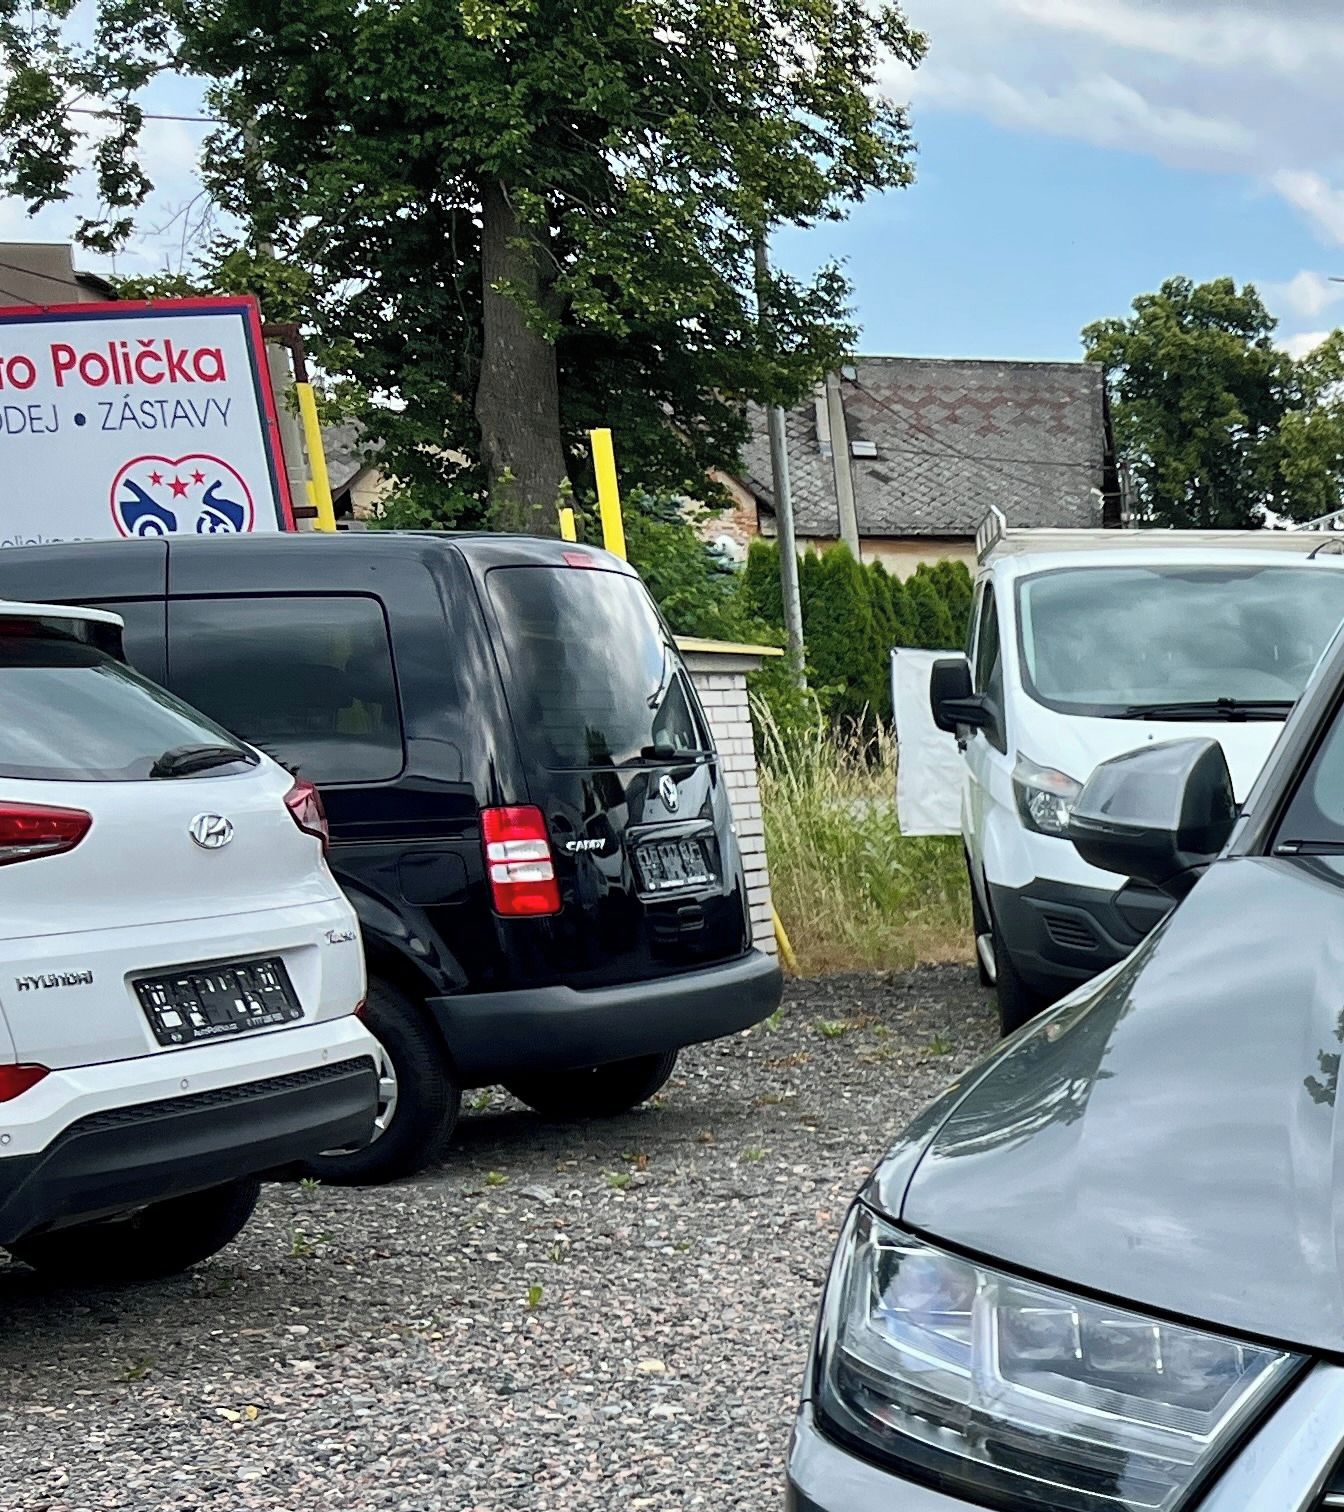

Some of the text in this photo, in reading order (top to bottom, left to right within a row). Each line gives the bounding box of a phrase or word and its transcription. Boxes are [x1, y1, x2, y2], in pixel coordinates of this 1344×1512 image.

[50, 338, 227, 387] Polička
[0, 393, 231, 434] DEJ ZÁSTAVY
